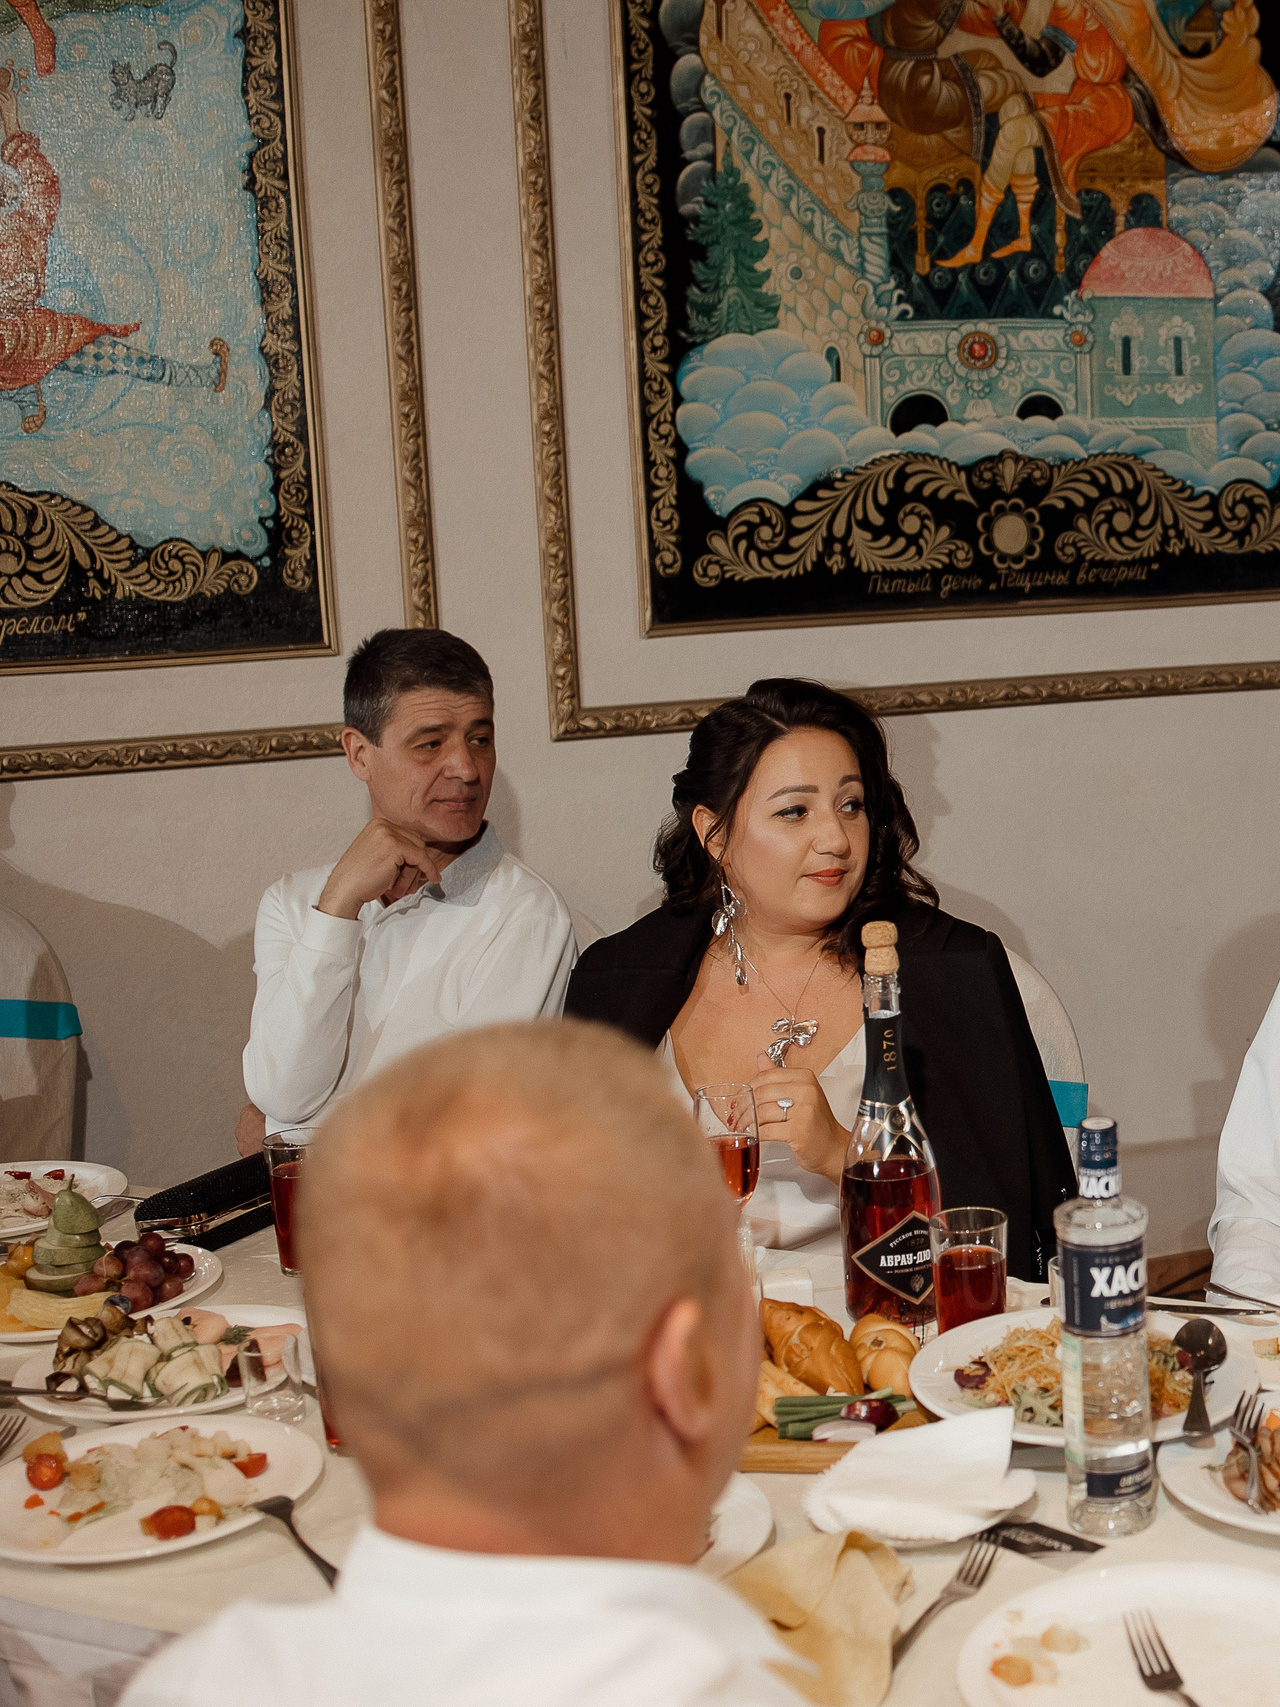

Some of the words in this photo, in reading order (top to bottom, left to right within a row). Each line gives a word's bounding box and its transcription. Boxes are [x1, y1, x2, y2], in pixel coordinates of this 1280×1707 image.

[867, 572, 932, 595] Пятый
[940, 573, 982, 599] день
[883, 1029, 897, 1072] 1870
